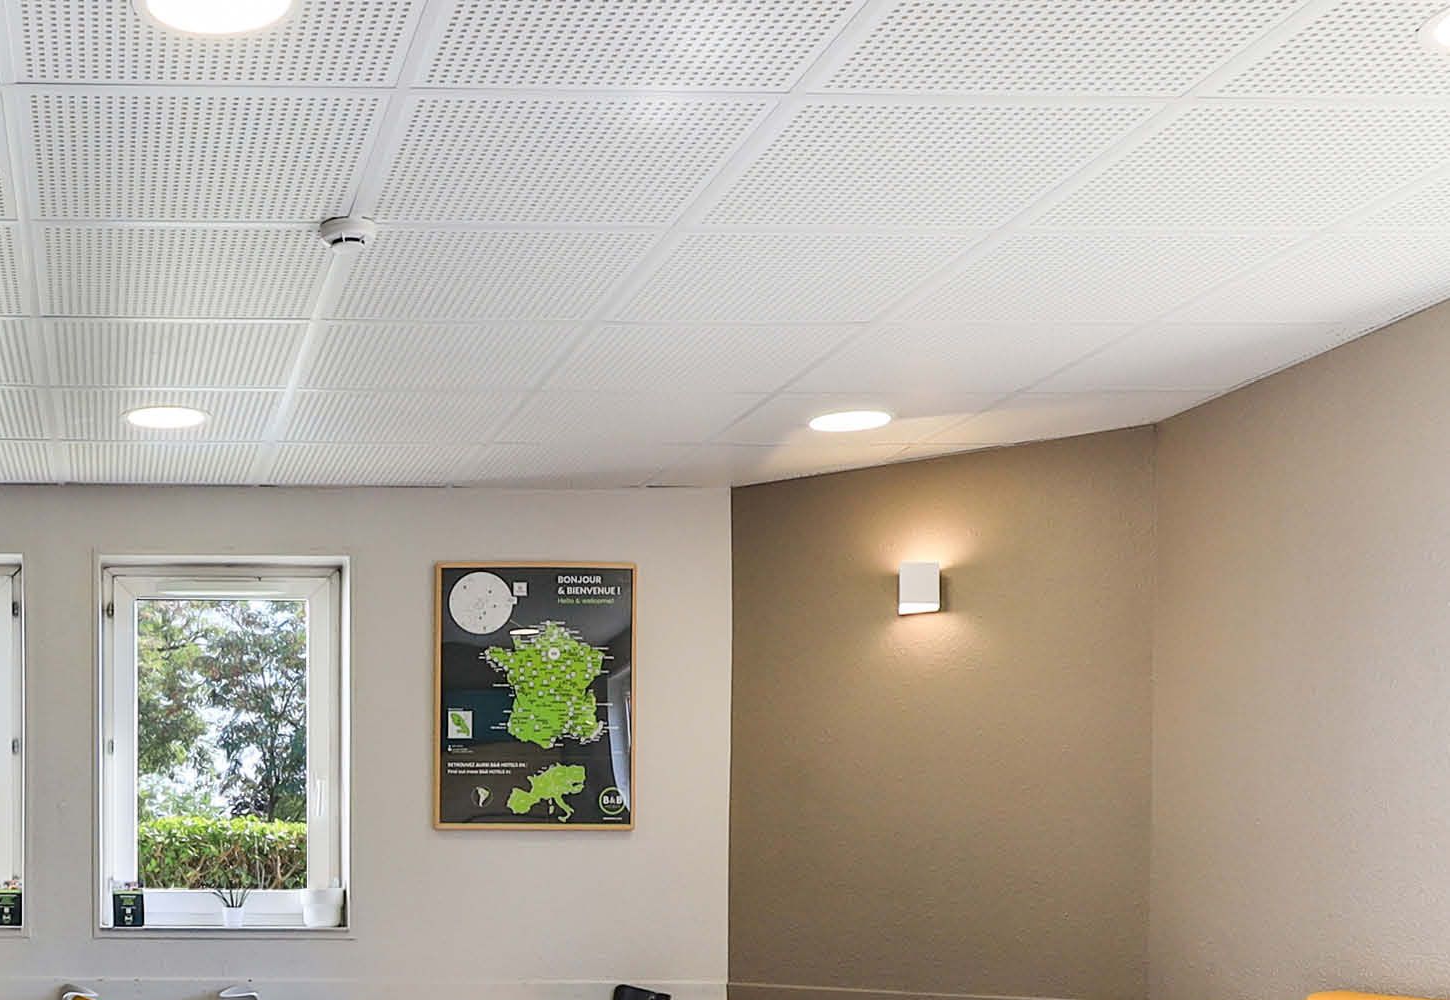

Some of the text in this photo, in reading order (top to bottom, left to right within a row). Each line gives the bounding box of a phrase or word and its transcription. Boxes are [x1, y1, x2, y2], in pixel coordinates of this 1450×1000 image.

[557, 575, 602, 584] BONJOUR
[557, 586, 566, 595] &
[566, 586, 616, 595] BIENVENUE
[603, 795, 623, 804] B&B
